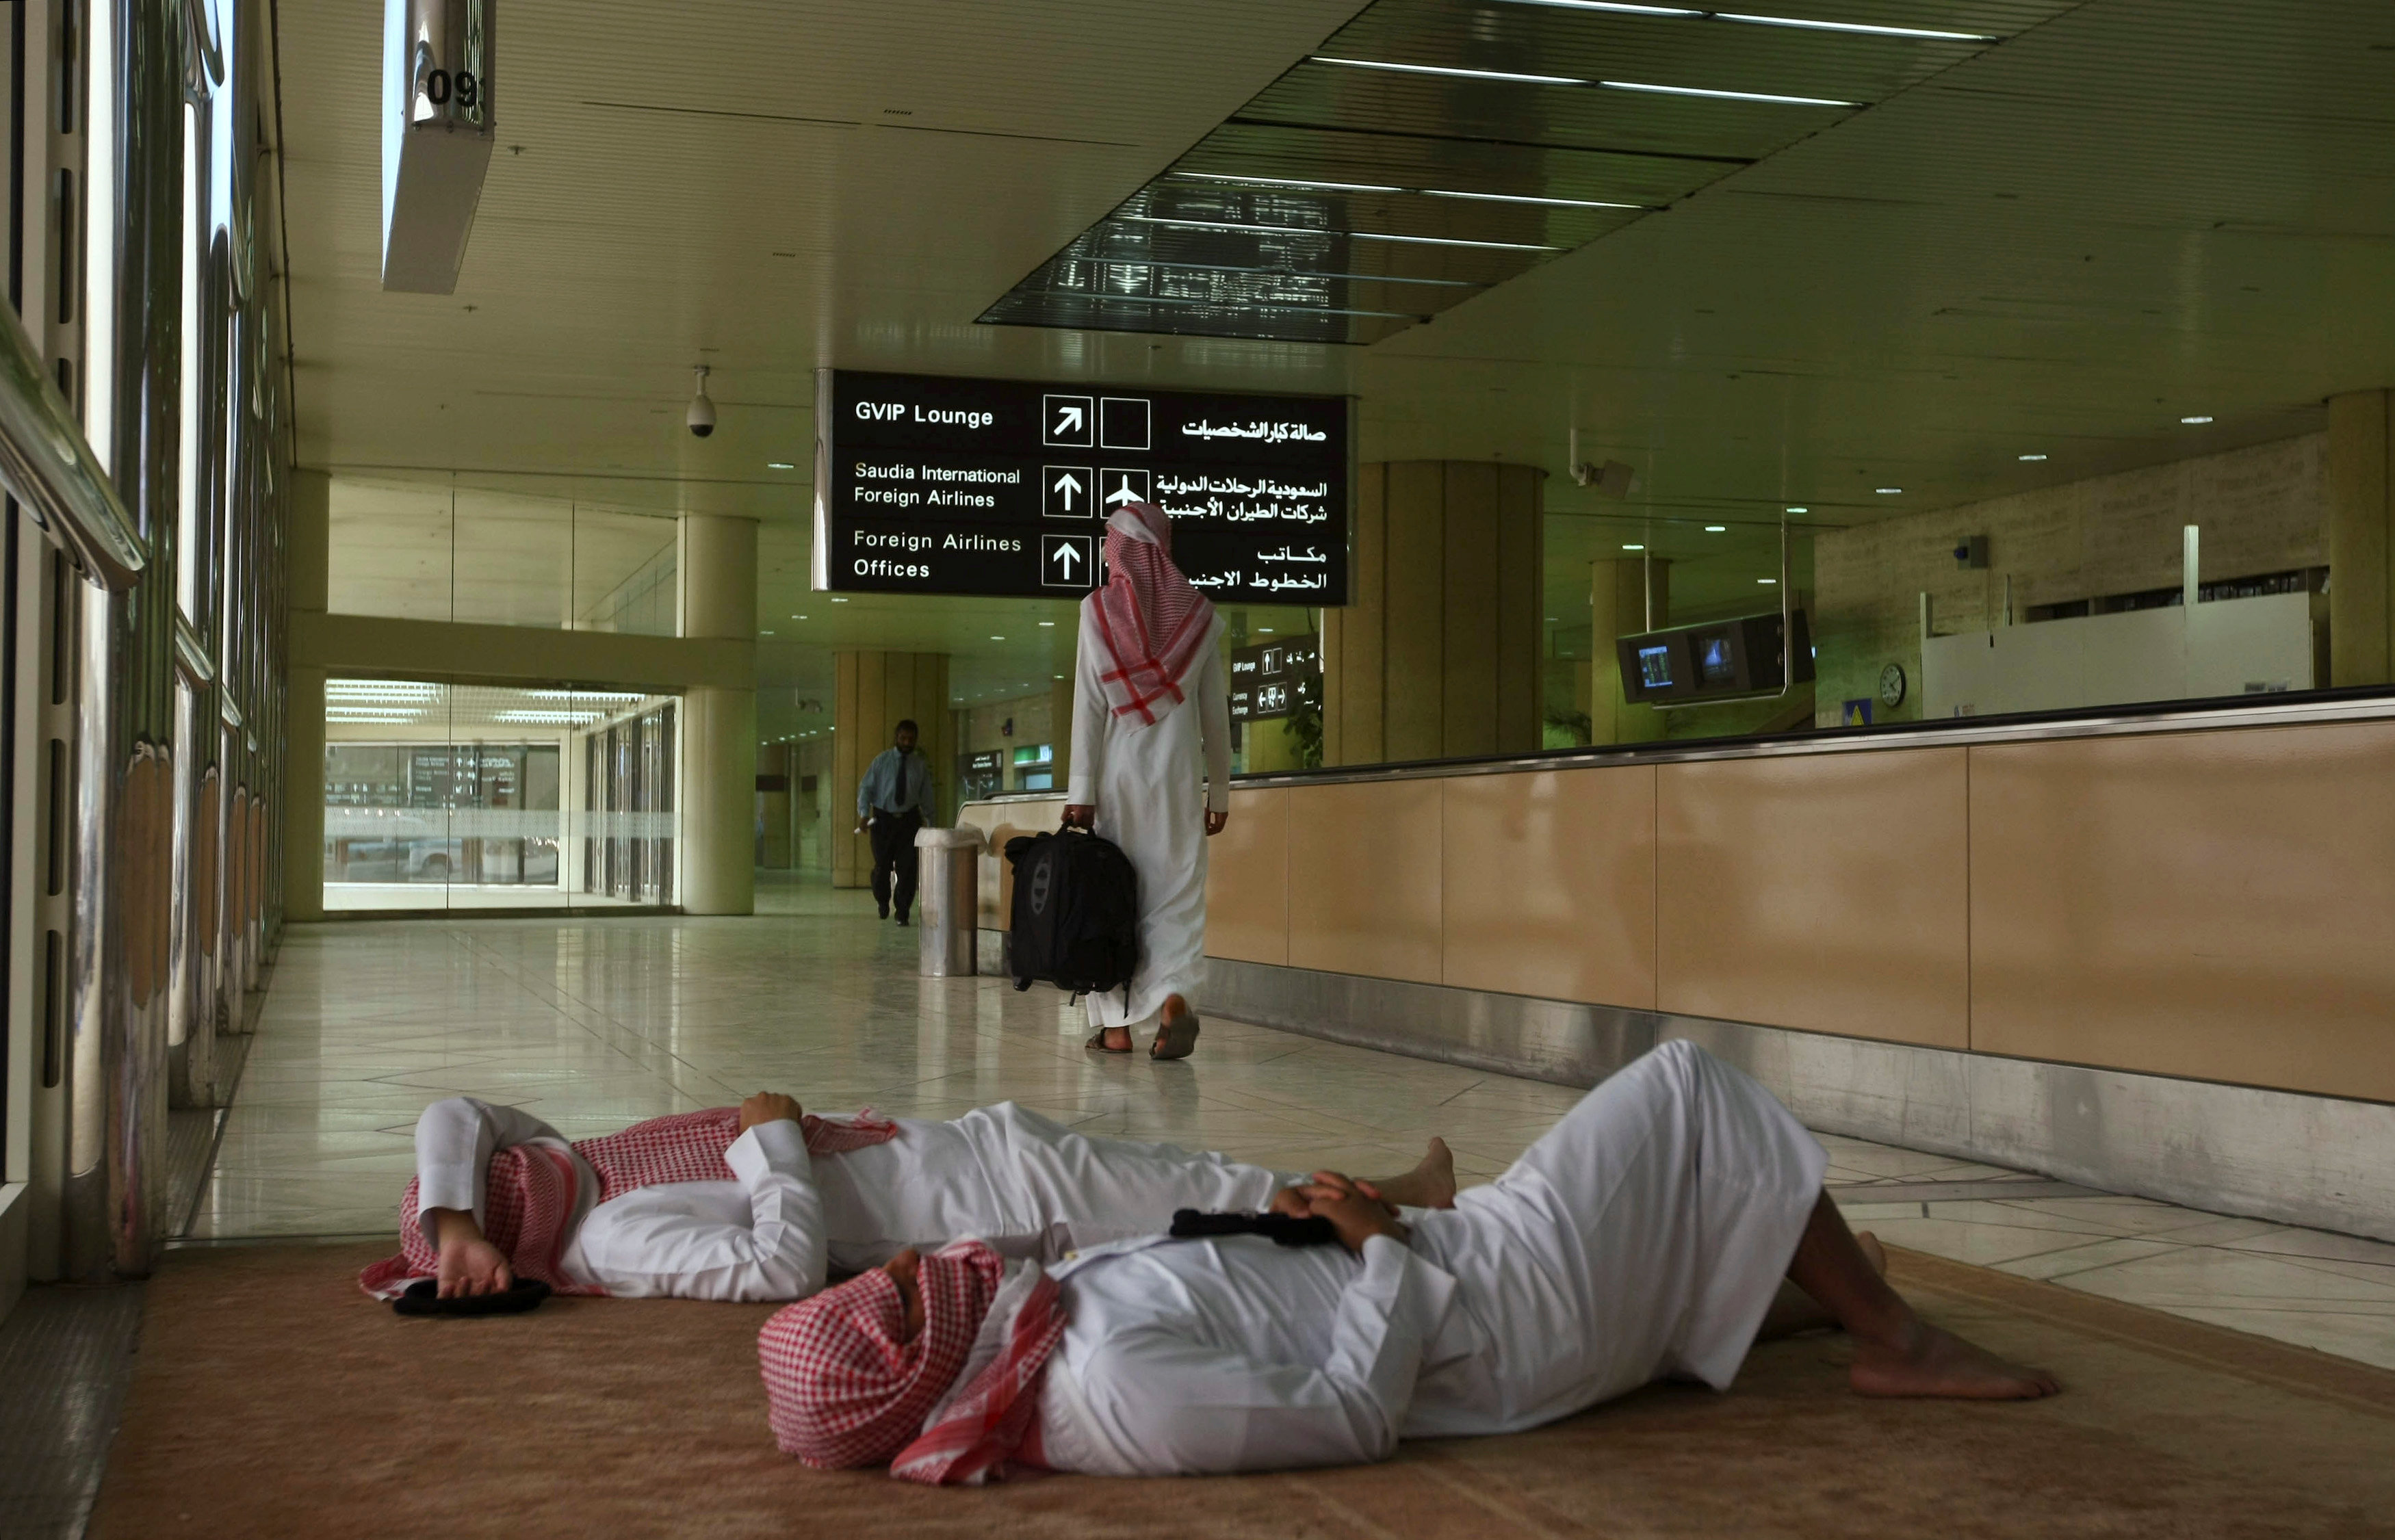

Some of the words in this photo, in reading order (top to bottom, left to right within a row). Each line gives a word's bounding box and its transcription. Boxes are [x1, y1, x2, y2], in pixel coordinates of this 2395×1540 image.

[855, 402, 905, 421] GVIP
[914, 404, 994, 429] Lounge
[1182, 419, 1269, 441] الشخصيات
[1265, 421, 1289, 443] كبار
[1289, 421, 1327, 441] صالة
[855, 462, 915, 480] Saudia
[922, 465, 1020, 484] International
[1156, 475, 1208, 495] الدولية
[1208, 478, 1266, 498] الرحلات
[1267, 480, 1328, 500] السعودية
[854, 486, 920, 508] Foreign
[927, 489, 995, 507] Airlines
[1226, 501, 1278, 521] الطيران
[1280, 504, 1328, 524] شركات
[854, 530, 932, 551] Foreign
[943, 534, 1022, 551] Airlines
[1257, 545, 1327, 564] مكاتب
[853, 558, 930, 577] Offices
[1248, 571, 1327, 592] الخطوط
